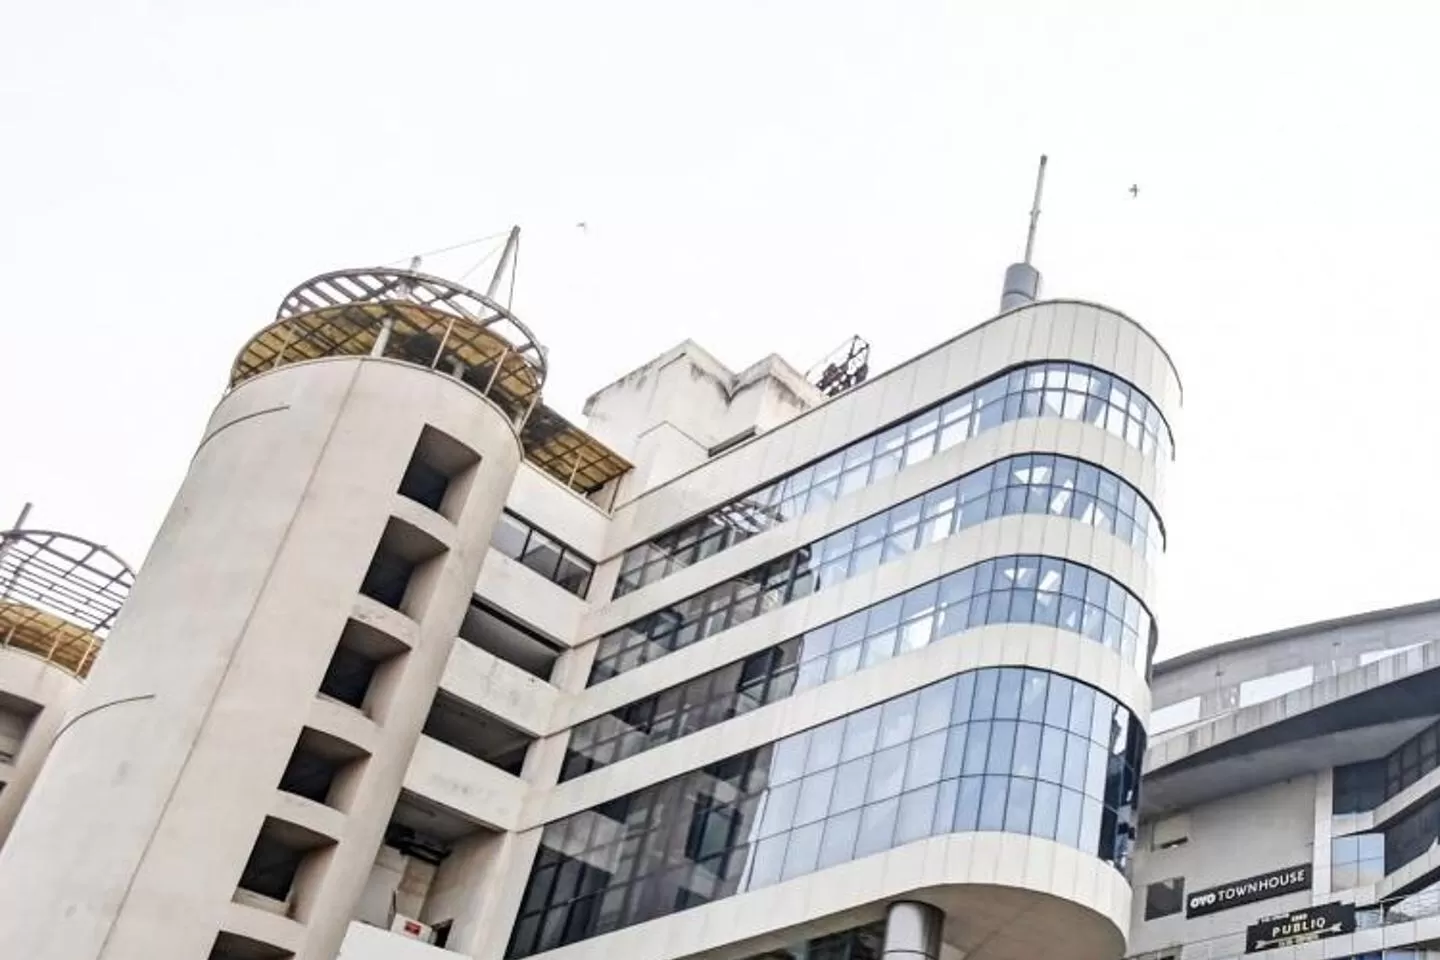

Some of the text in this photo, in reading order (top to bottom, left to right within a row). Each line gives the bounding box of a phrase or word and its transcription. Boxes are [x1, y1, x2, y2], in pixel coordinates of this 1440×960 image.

[1190, 869, 1305, 908] OYO TOWNHOUSE
[1272, 917, 1326, 938] PUBLIQ
